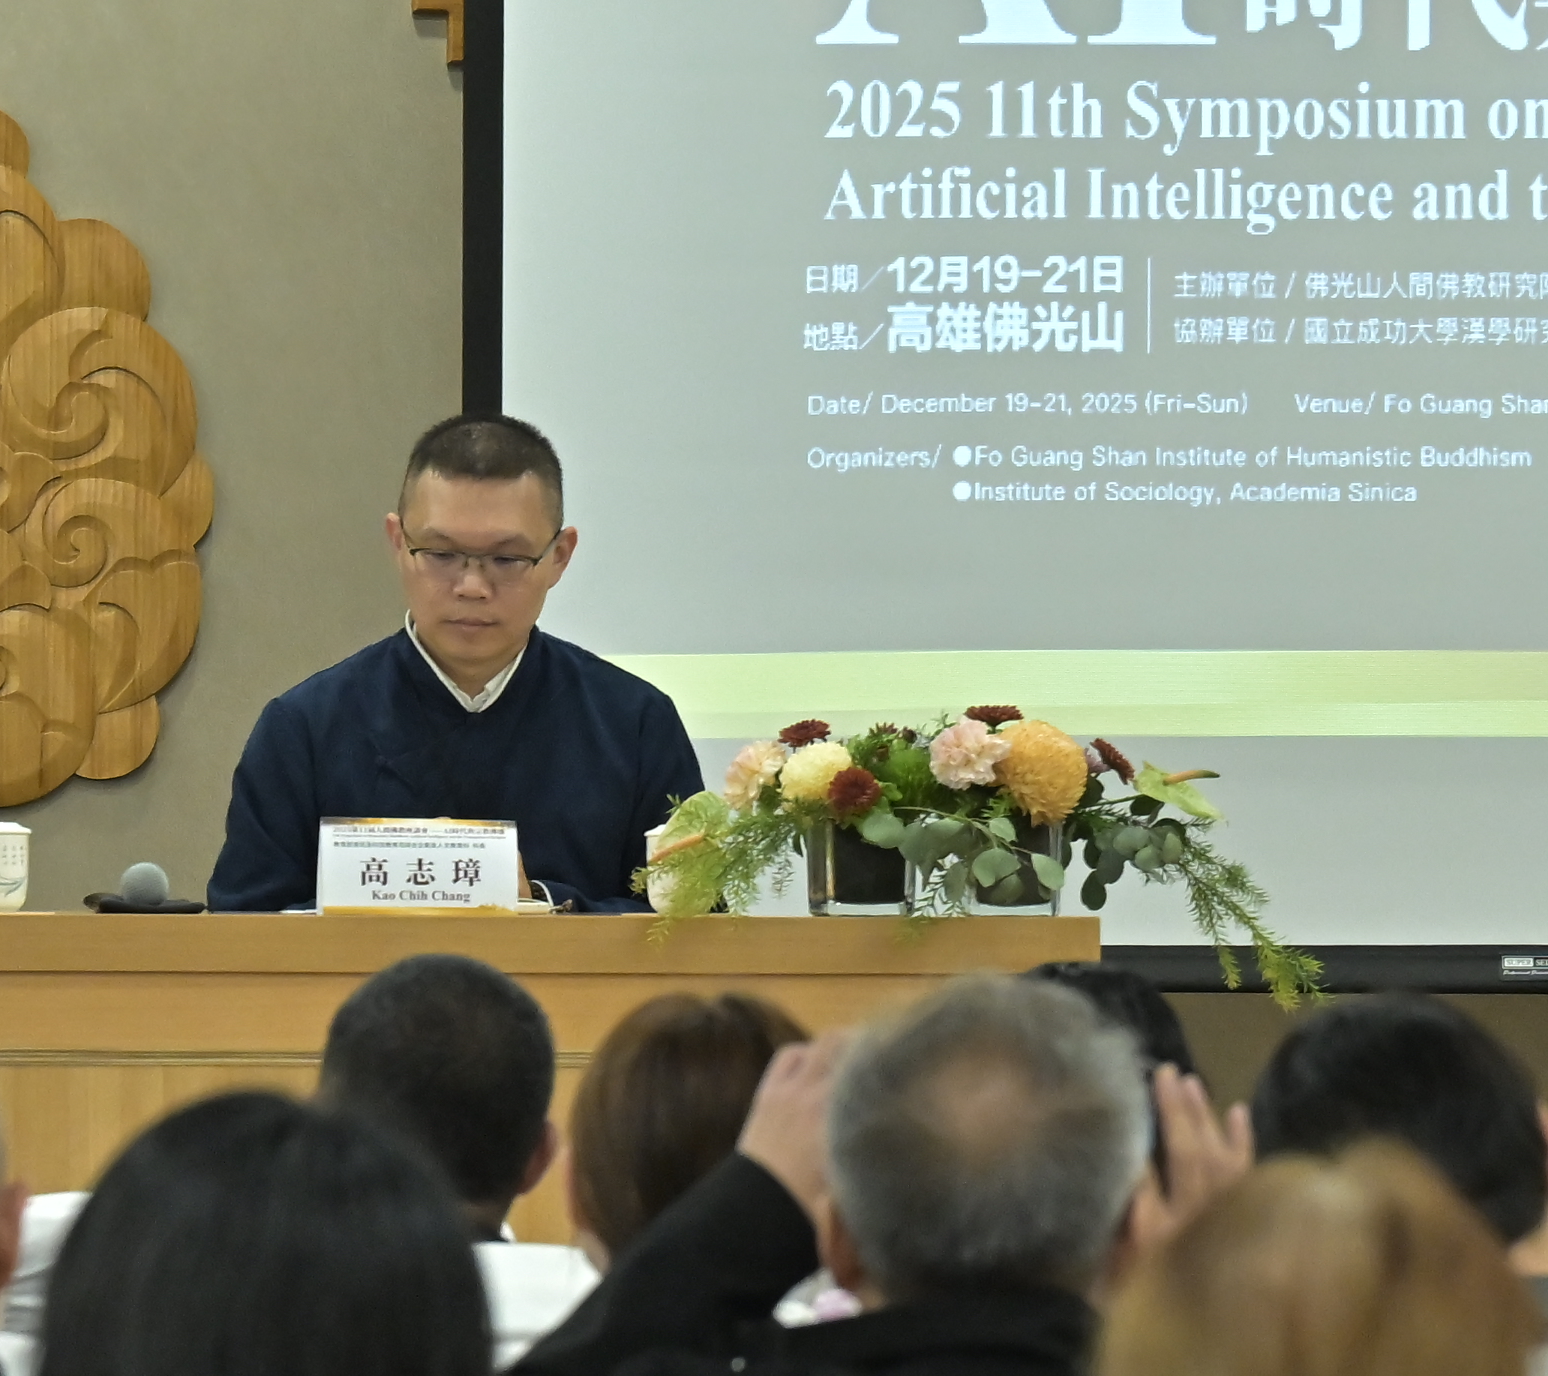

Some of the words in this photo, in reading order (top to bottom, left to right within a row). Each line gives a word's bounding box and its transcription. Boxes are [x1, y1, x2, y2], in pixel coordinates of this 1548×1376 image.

[824, 79, 961, 139] 2025
[986, 80, 1104, 138] 11th
[1125, 80, 1466, 157] Symposium
[824, 165, 1067, 221] Artificial
[1087, 167, 1393, 236] Intelligence
[1412, 168, 1510, 221] and
[807, 391, 874, 416] Date/
[881, 393, 997, 414] December
[1081, 392, 1138, 414] 2025
[1294, 391, 1376, 415] Venue/
[1384, 393, 1413, 414] Fo
[1420, 393, 1493, 419] Guang
[807, 444, 942, 473] Organizers/
[975, 446, 1003, 468] Fo
[1011, 445, 1083, 473] Guang
[1092, 445, 1147, 468] Shan
[1155, 446, 1247, 468] Institute
[1255, 446, 1278, 468] of
[1286, 446, 1412, 468] Humanistic
[1420, 445, 1532, 468] Buddhism
[973, 480, 1066, 502] Institute
[1073, 481, 1097, 502] of
[1104, 481, 1221, 508] Sociology,
[1229, 482, 1341, 502] Academia
[1348, 482, 1417, 502] Sinica
[360, 857, 482, 887] 高志璋
[372, 890, 396, 901] Kao
[399, 890, 428, 901] Chih
[431, 890, 471, 904] Chang
